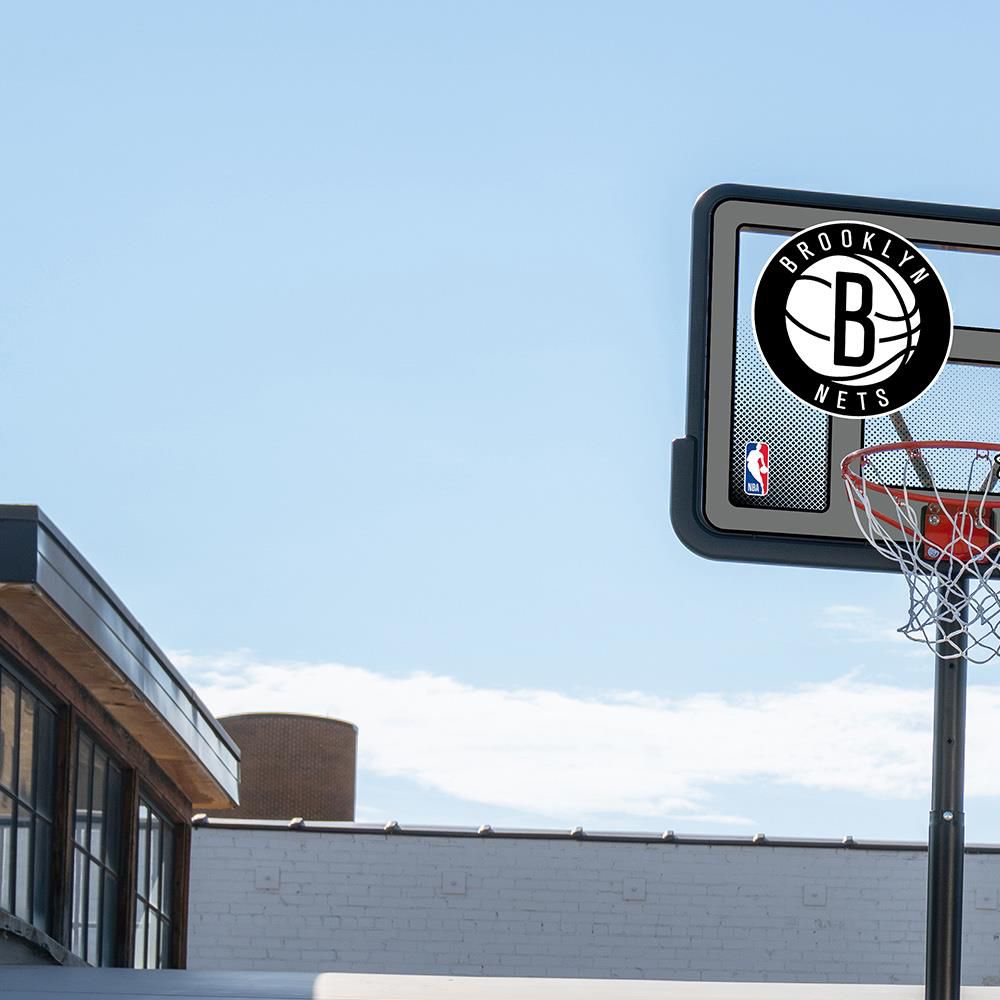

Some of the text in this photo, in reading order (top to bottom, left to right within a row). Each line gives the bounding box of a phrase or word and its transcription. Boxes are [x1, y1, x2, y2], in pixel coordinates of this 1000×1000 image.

[779, 229, 929, 284] BROOKLYN
[833, 271, 875, 367] B
[814, 383, 889, 410] NETS
[747, 482, 760, 492] NBA
